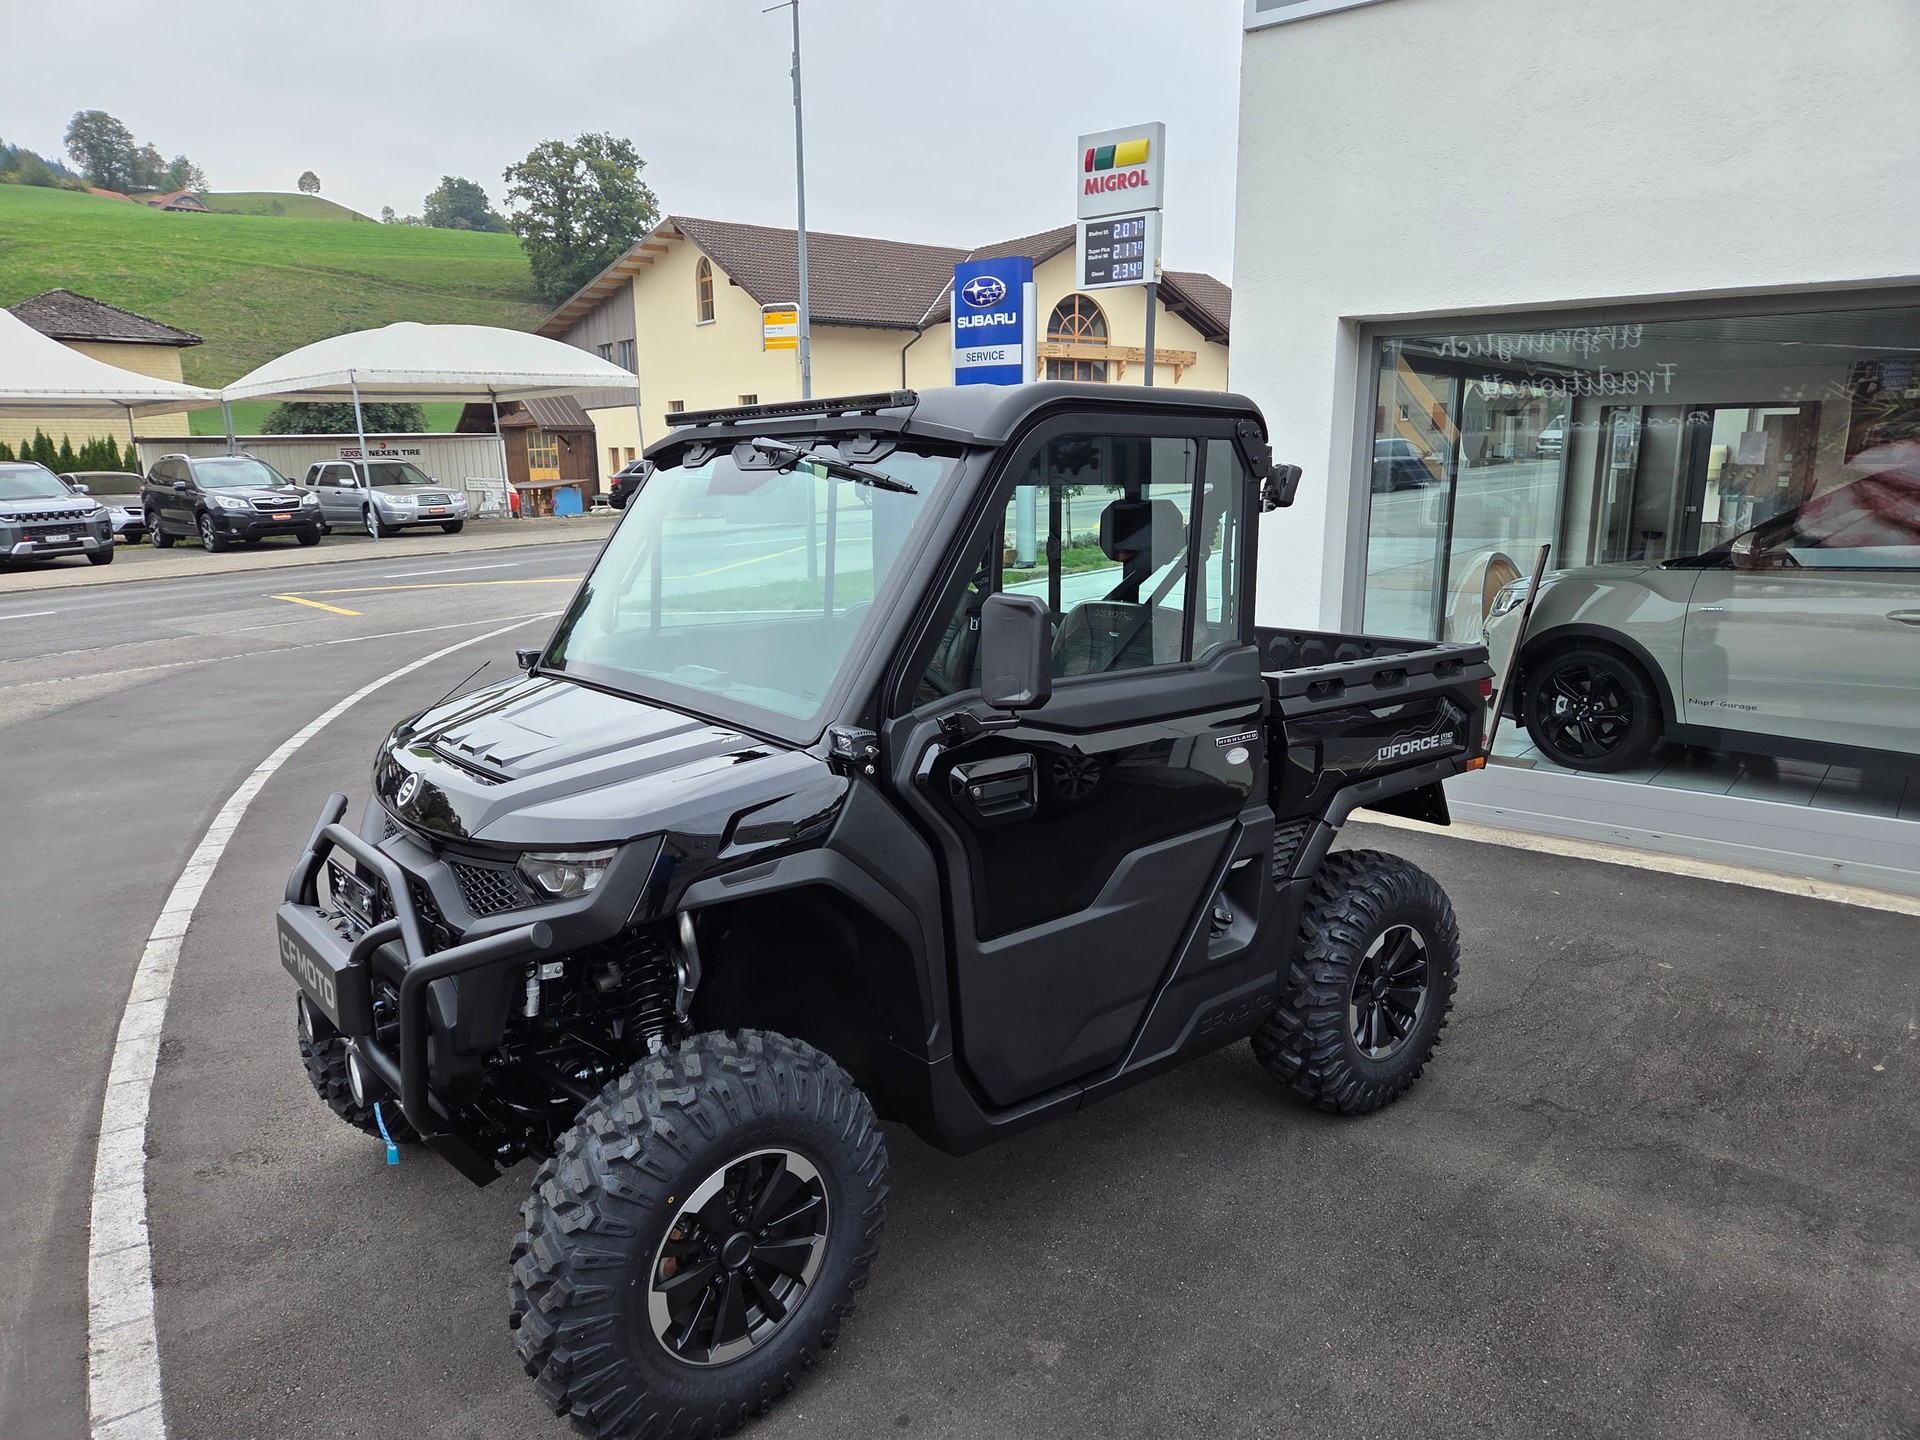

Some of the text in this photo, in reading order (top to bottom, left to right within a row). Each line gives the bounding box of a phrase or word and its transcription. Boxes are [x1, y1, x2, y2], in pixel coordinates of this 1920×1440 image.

[1084, 169, 1149, 195] MIGROL
[957, 312, 1016, 328] SUBARU
[966, 350, 1005, 362] SERVICE
[1688, 698, 1758, 711] Napf-Garage
[1218, 732, 1257, 745] HIGHLAND
[280, 931, 335, 1010] CFMOTO
